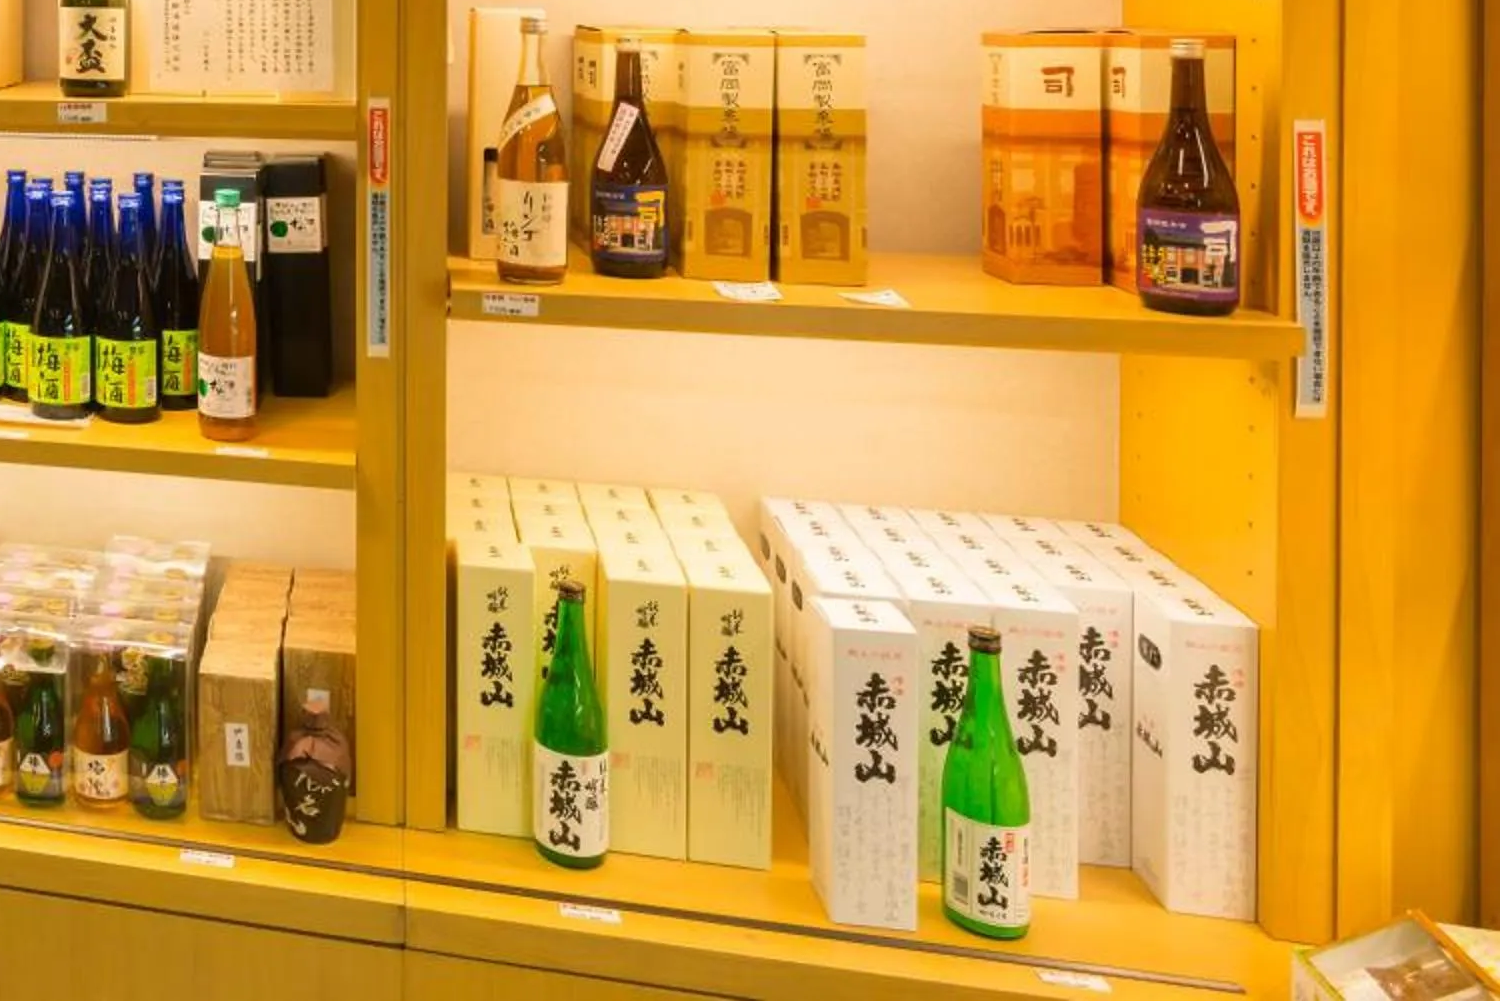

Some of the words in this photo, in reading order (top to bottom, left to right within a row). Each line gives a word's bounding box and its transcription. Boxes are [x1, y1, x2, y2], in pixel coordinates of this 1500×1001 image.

[1040, 65, 1075, 98] 司
[636, 190, 666, 229] 司
[1200, 220, 1237, 263] 司
[38, 341, 61, 401] 梅酒
[103, 345, 126, 404] 梅酒
[480, 621, 514, 709] 赤城山
[629, 637, 665, 727] 赤城山
[713, 646, 749, 735] 赤城山
[930, 641, 974, 749] 赤城山
[1016, 649, 1061, 757] 赤城山
[1078, 626, 1113, 731] 赤城山
[855, 672, 899, 784] 赤城山
[1192, 664, 1239, 776] 赤城山
[548, 759, 582, 852] 赤城山
[977, 836, 1009, 911] 赤城山
